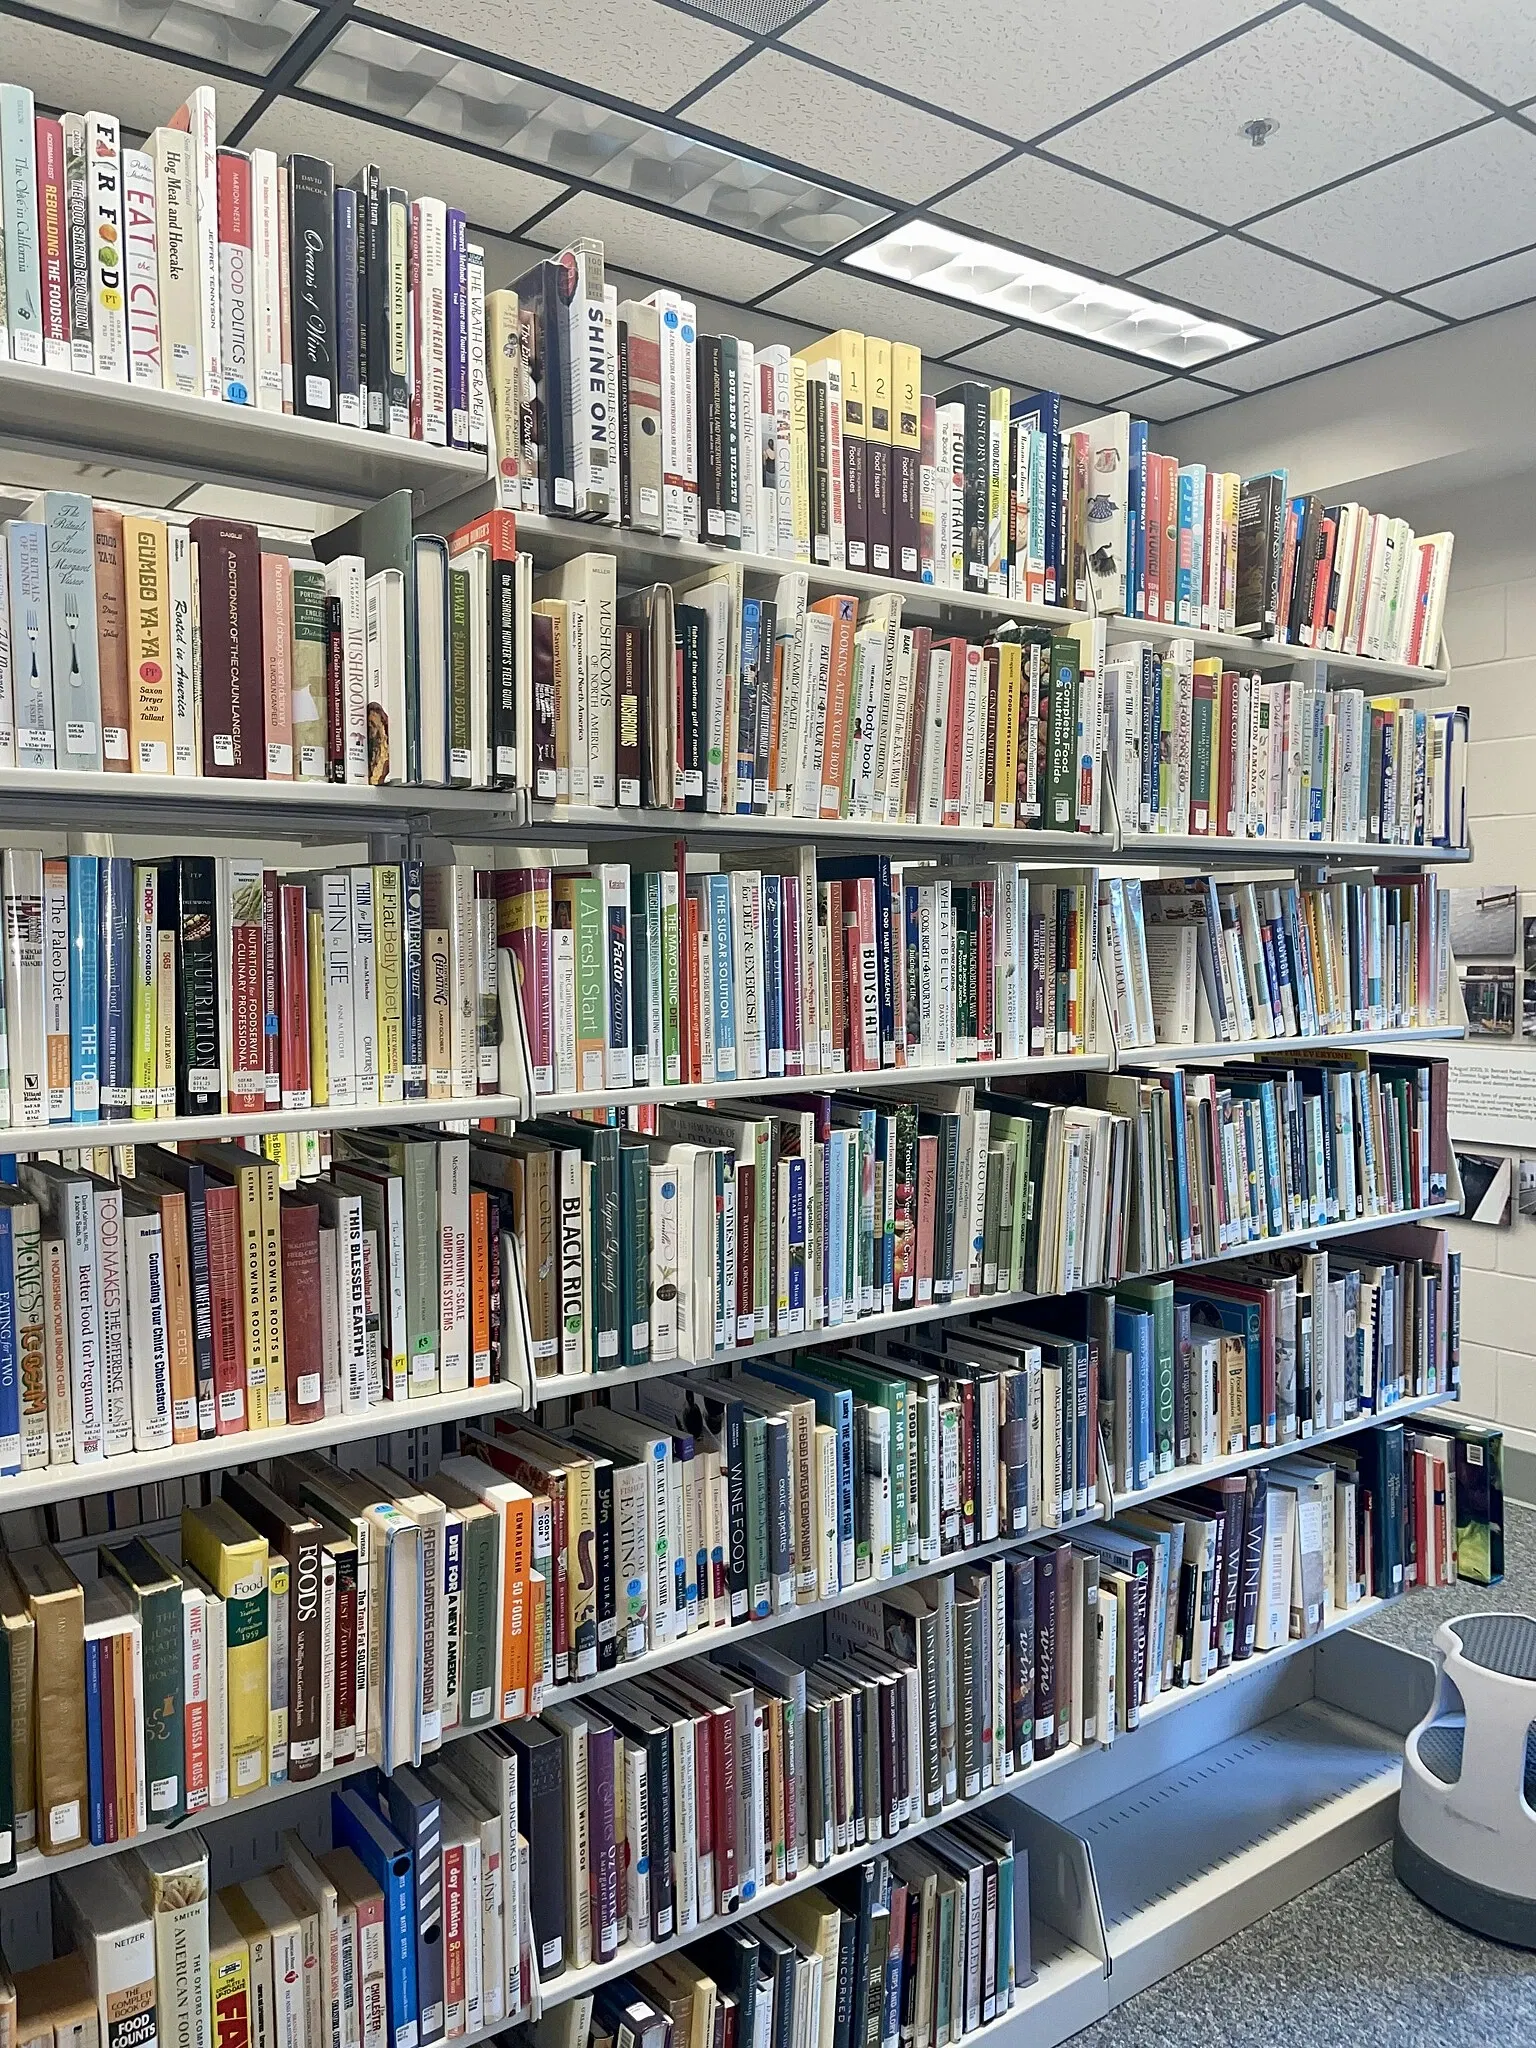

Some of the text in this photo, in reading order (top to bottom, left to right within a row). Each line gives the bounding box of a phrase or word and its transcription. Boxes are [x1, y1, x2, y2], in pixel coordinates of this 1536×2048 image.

[128, 190, 155, 252] EAT
[165, 151, 184, 280] Hog Meat and Hoecake
[46, 185, 62, 340] REBUILDING THE FOODSHE
[72, 180, 88, 328] THE FOOD SHARING REVOLUTION
[137, 261, 150, 271] the
[303, 228, 325, 289] Oceans
[131, 284, 160, 366] CITY
[231, 249, 246, 364] FOOD POLITICS
[301, 290, 318, 310] of
[306, 313, 331, 362] Wine
[588, 308, 606, 394] SHINE
[850, 371, 858, 388] 1
[876, 378, 885, 395] 2
[904, 384, 914, 400] 3
[590, 402, 607, 442] ON
[728, 370, 738, 503] BOURBON & BULLETS
[228, 551, 236, 562] A
[502, 518, 511, 552] Smith
[138, 532, 160, 659] GUMBO YA-YA
[229, 564, 238, 625] DICTIONARY
[174, 600, 188, 718] Rooted in America
[230, 628, 238, 644] OF
[502, 574, 512, 710] the MUSHROOM HUNTER'S FIELD GUIDE
[600, 600, 612, 708] MUSHROOMS
[140, 686, 163, 696] Saxon
[140, 696, 164, 706] Dreyer
[348, 627, 364, 726] MUSHROOMS
[590, 655, 600, 760] OF NORTH AMERICA
[140, 713, 164, 722] Tallant
[232, 705, 242, 764] LANGUAGE
[620, 694, 638, 747] MUSHROOMS
[862, 705, 876, 780] body book
[1054, 692, 1062, 746] Nutrition
[1062, 682, 1072, 773] Complete Food
[1251, 679, 1260, 798] NUTRITION ALMANAC
[1054, 749, 1062, 784] Guide
[52, 896, 67, 1001] The Paleo Diet
[238, 944, 246, 990] CULINARY
[248, 930, 257, 984] NUTRITION
[381, 892, 400, 1021] Flat Belly Diet!
[581, 902, 600, 1032] A Fresh Start
[940, 886, 950, 992] WHEAT BELLY
[194, 951, 215, 1067] NUTRITION
[612, 924, 625, 1042] T-Factor 2000 Diet
[863, 950, 878, 1035] BODYSTAT
[239, 994, 248, 1071] PROFESSIONALS
[250, 999, 258, 1064] FOODSERVICE
[451, 1156, 459, 1196] McSweeney
[902, 1142, 913, 1273] Producing Vegetable Crops
[249, 1242, 261, 1352] GROWING ROOTS
[268, 1242, 280, 1351] GROWING ROOTS
[349, 1207, 365, 1358] THIS BLESSED EARTH
[443, 1226, 453, 1331] COMPOSTING SYSTEMS
[456, 1232, 465, 1321] COMMUNITY-SCALE
[80, 1264, 98, 1425] Better Food for Pregnancy
[149, 1252, 168, 1415] Combating Your Child's Cholesterol
[1160, 1356, 1172, 1422] FOOD
[580, 1470, 592, 1526] Delizia!
[731, 1462, 745, 1574] WINE FOOD
[620, 1496, 636, 1578] EATING
[1243, 1524, 1262, 1607] WINE
[234, 1579, 264, 1594] Food
[298, 1543, 318, 1622] FOODS
[512, 1512, 524, 1636] EDWARD BEHR 50 FOODS
[1226, 1548, 1240, 1614] WINE
[192, 1638, 200, 1651] all
[242, 1629, 260, 1640] 1959
[447, 1534, 459, 1698] DIET FOR A NEW AMERICA
[192, 1652, 200, 1670] the
[192, 1672, 200, 1700] time.
[1019, 1628, 1034, 1698] wine
[1040, 1626, 1053, 1696] wine
[508, 1763, 518, 1872] WINE UNCORKED
[174, 1908, 200, 1923] SMITH
[449, 1867, 461, 1937] day drinking
[988, 1878, 996, 1912] WHISKY
[114, 1932, 146, 1950] NETZER
[175, 1928, 189, 2007] AMERICAN
[112, 1990, 153, 2010] COMPLETE
[124, 1987, 140, 1998] THE
[838, 1946, 848, 2023] UNCORKED
[112, 2022, 156, 2048] COUNTS
[118, 2014, 150, 2036] FOOD
